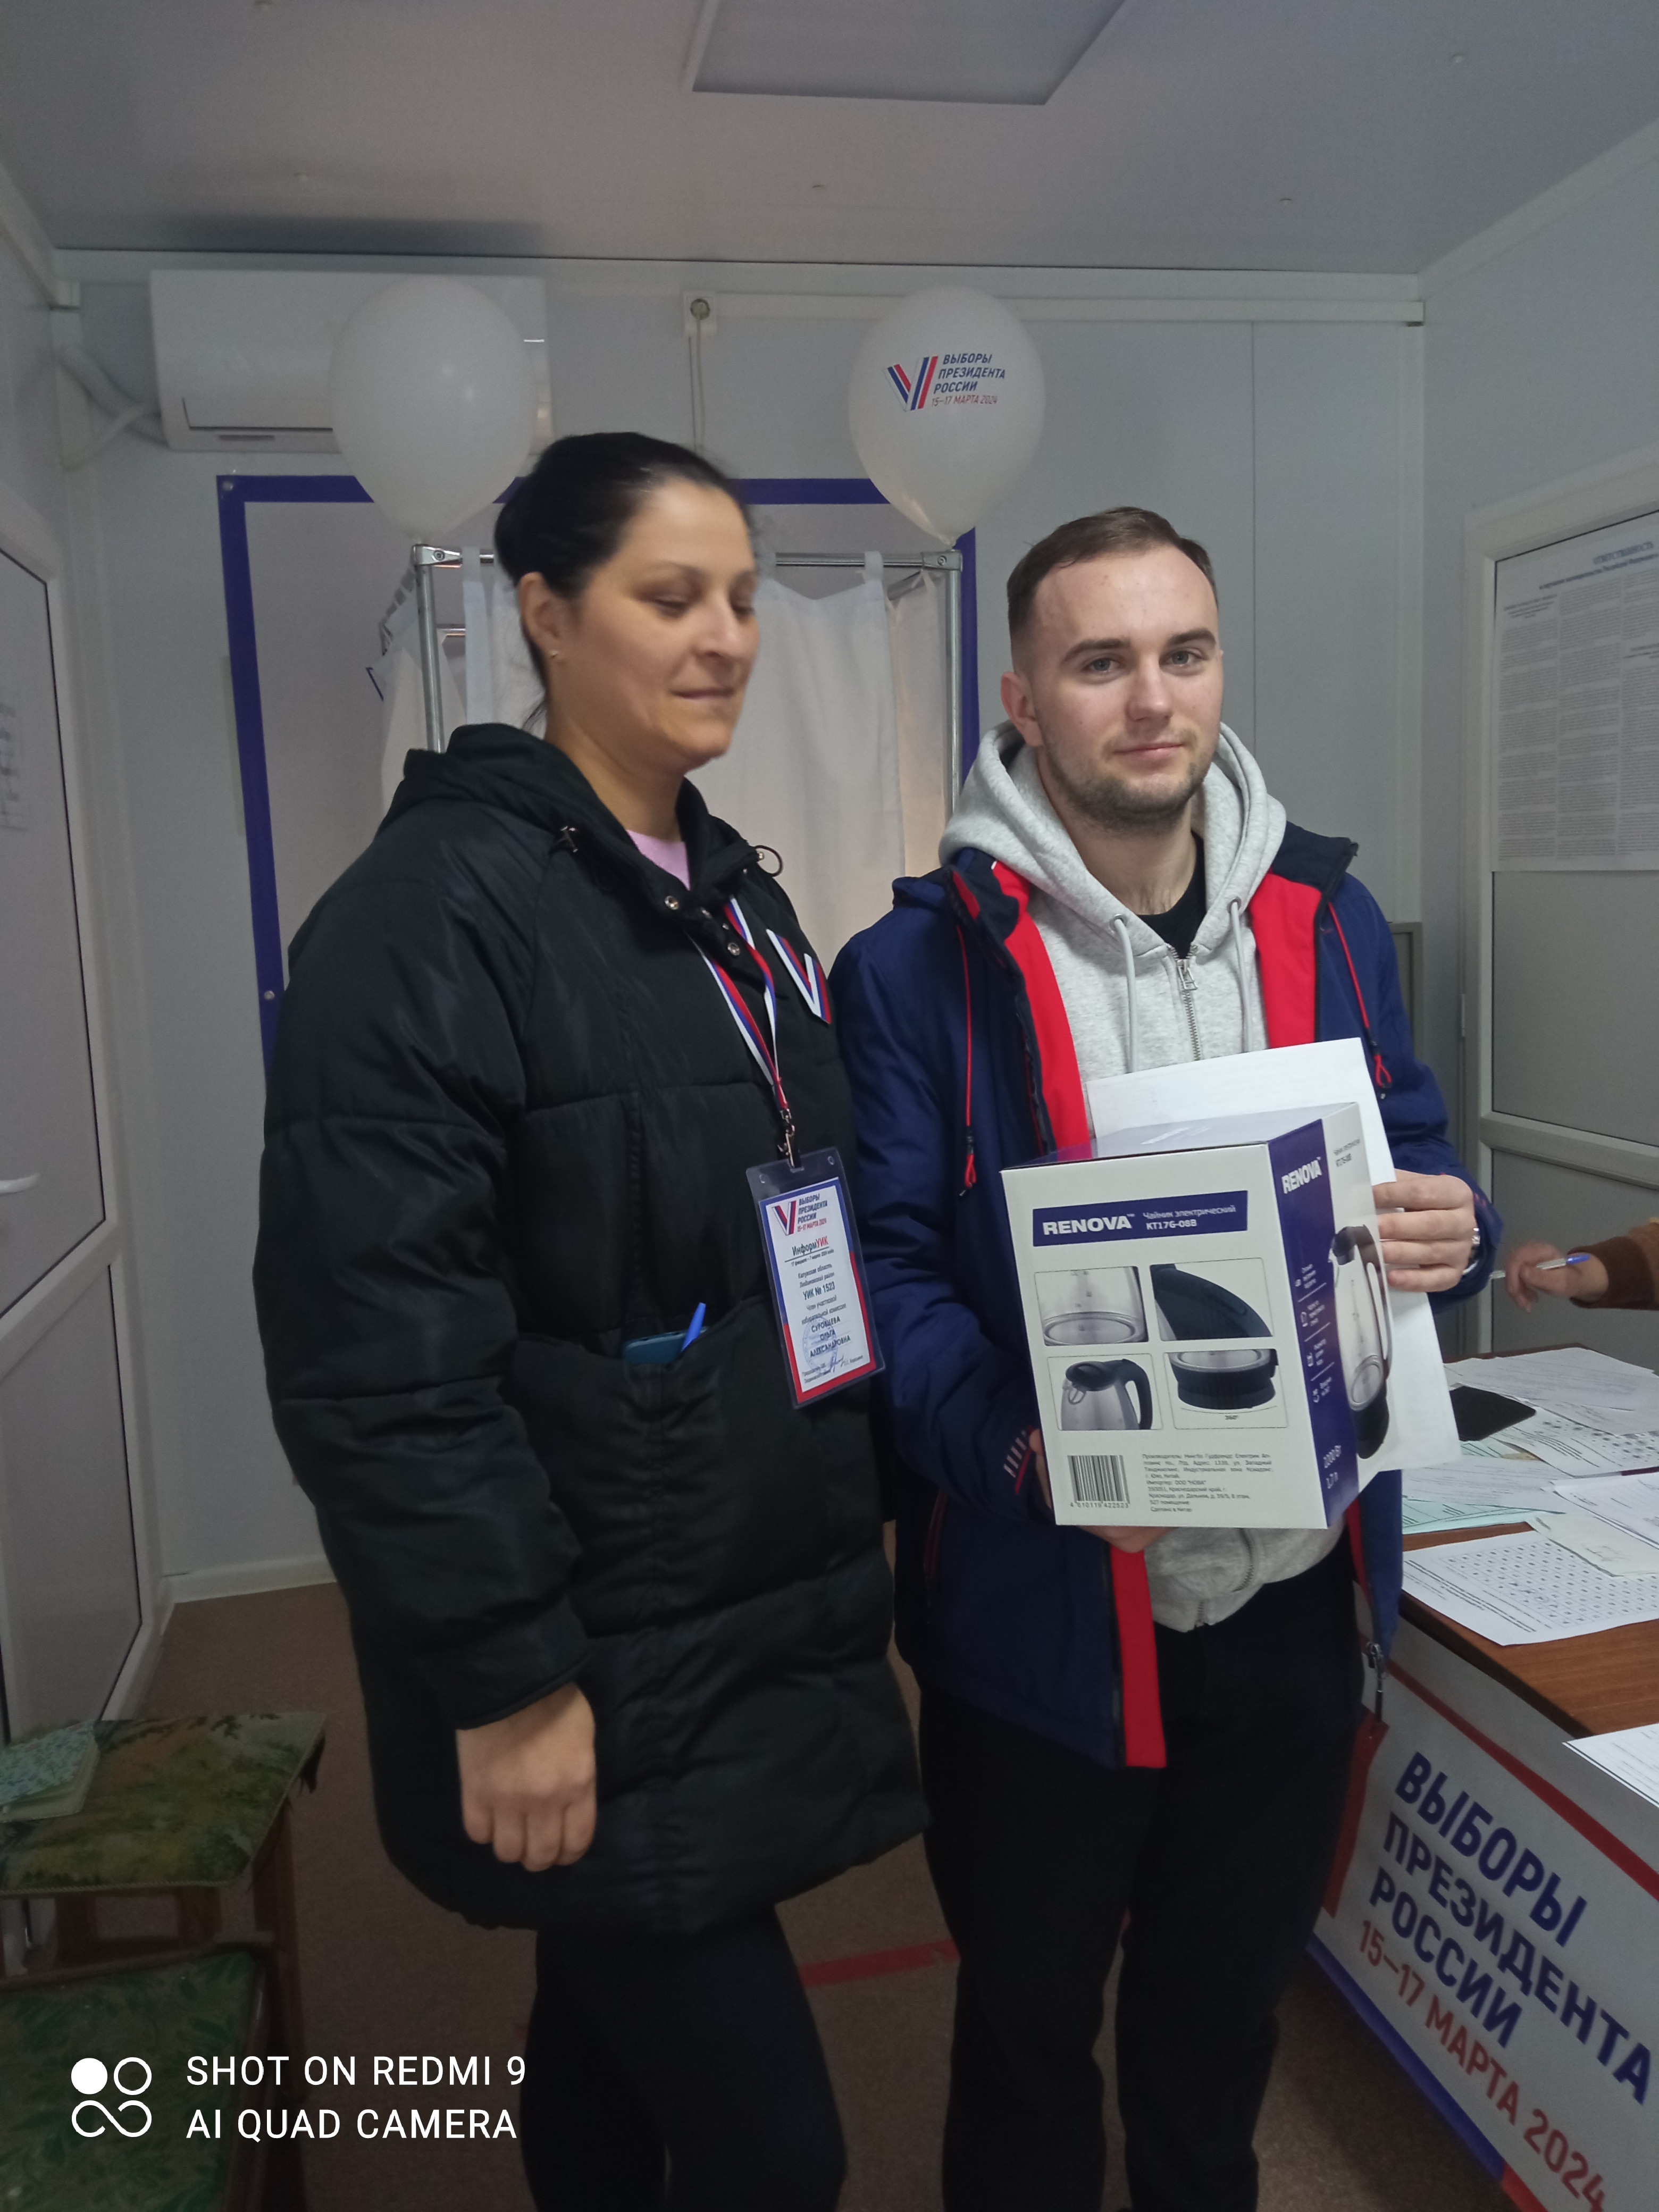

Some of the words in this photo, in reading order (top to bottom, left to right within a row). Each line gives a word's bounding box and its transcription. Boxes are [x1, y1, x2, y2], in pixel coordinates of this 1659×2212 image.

[943, 353, 992, 365] ВЫБОРЫ
[938, 367, 1006, 379] ПРЕЗИДЕНТА
[933, 381, 978, 395] РОССИИ
[953, 395, 979, 405] МАРТА
[981, 394, 998, 405] 2024
[1281, 1159, 1322, 1194] RENOVA
[798, 1200, 827, 1215] ПРЕЗИДЕНТА
[799, 1193, 819, 1206] ВЫБОРЫ
[798, 1212, 816, 1224] РОССИИ
[1143, 1210, 1173, 1220] Чайник
[1174, 1204, 1236, 1219] электрический
[792, 1236, 828, 1256] ИнформУИК
[803, 1288, 815, 1301] УИК
[822, 1281, 835, 1293] 1523
[1394, 1750, 1588, 1948] ВЫБОРЫ
[1369, 1865, 1523, 2049] РОССИИ
[1382, 1811, 1652, 2106] ПРЕЗИДЕНТА
[1425, 1994, 1522, 2126] МАРТА
[1522, 2107, 1607, 2212] 2024
